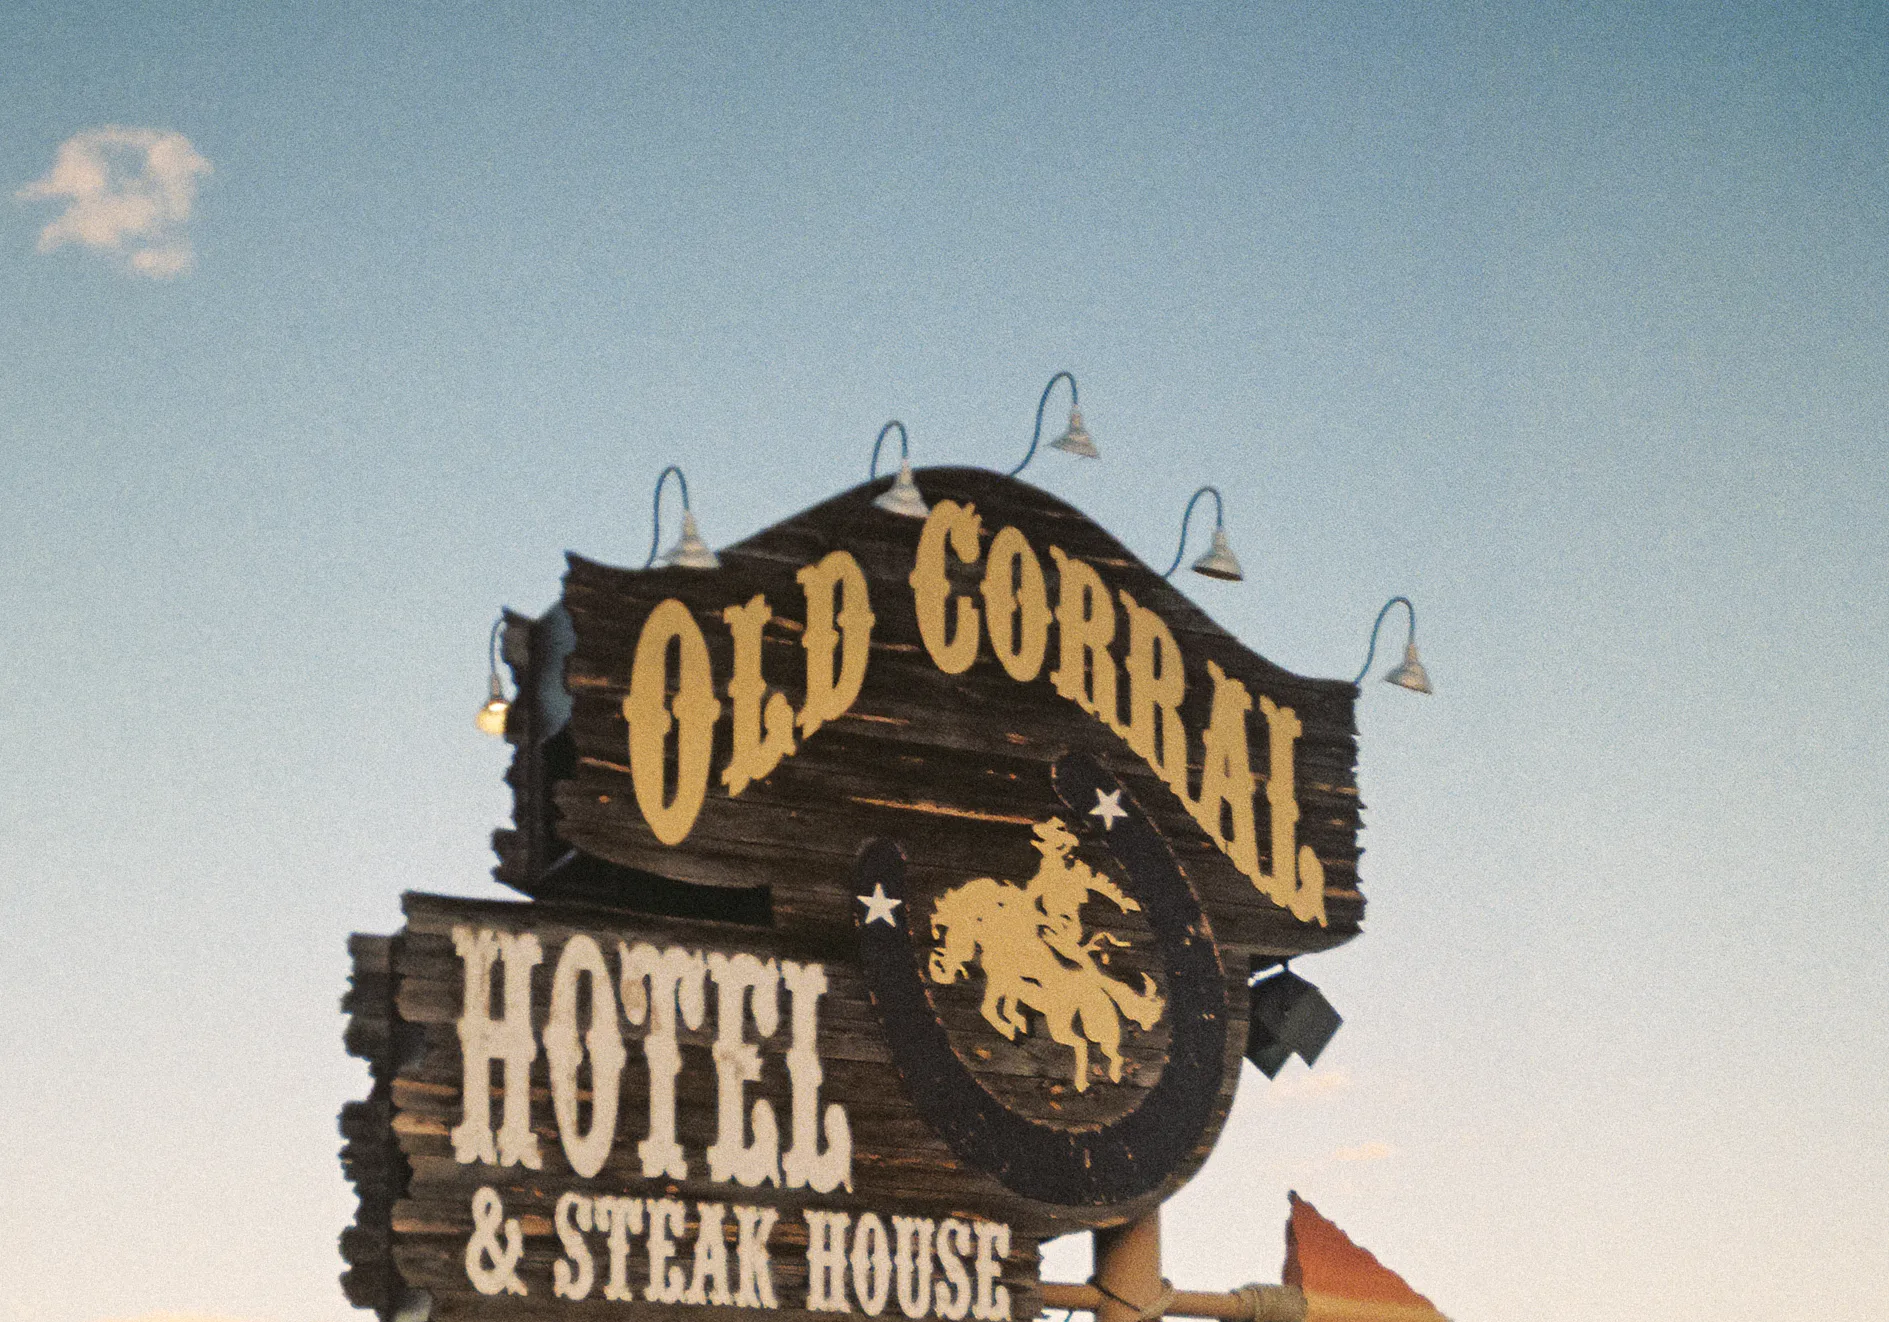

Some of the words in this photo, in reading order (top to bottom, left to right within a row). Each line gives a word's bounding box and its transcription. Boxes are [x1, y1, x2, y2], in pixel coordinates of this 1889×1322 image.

[622, 550, 876, 846] OLD
[909, 498, 1329, 928] CORRAL
[450, 925, 854, 1194] HOTEL
[464, 1187, 528, 1297] &
[553, 1192, 779, 1310] STEAK
[803, 1208, 1013, 1322] HOUSE
